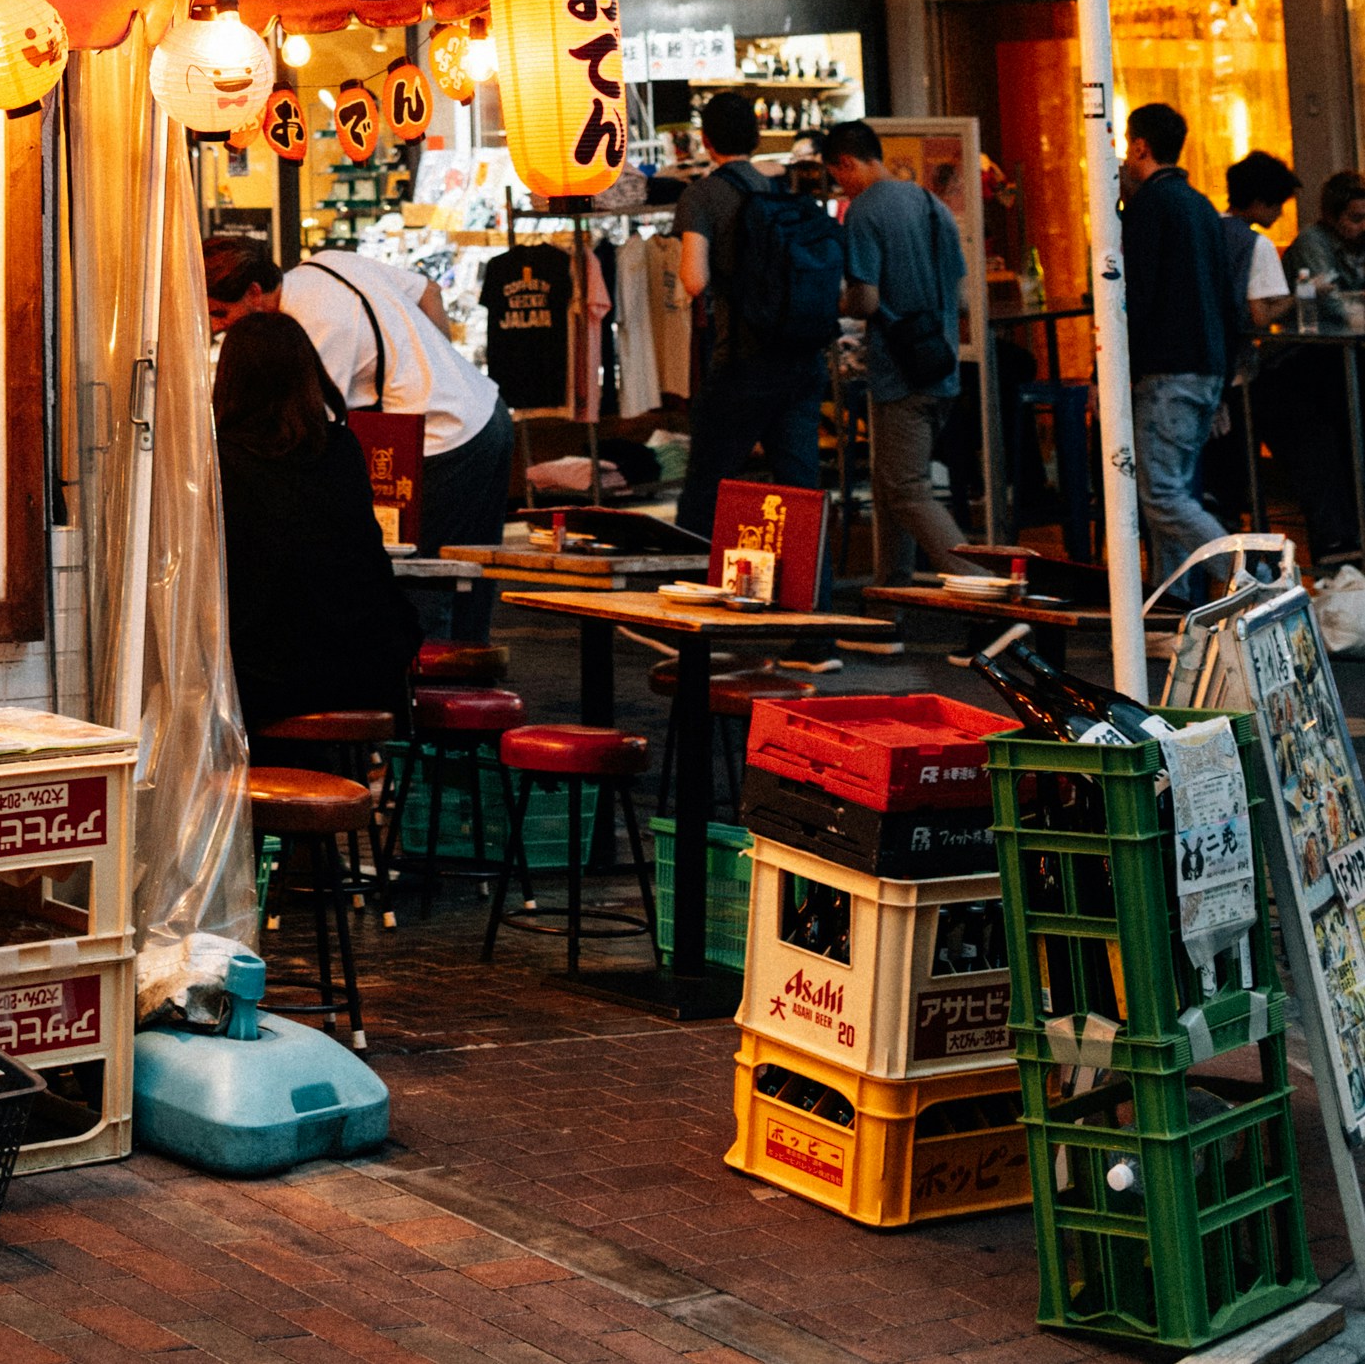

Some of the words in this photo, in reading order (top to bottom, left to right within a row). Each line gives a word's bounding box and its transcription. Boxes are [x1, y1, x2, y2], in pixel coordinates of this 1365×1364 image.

[784, 968, 845, 1015] Asahi
[770, 995, 787, 1021] 大
[792, 1002, 813, 1022] ASAHI
[815, 1012, 833, 1030] BEER
[837, 1021, 856, 1048] 20
